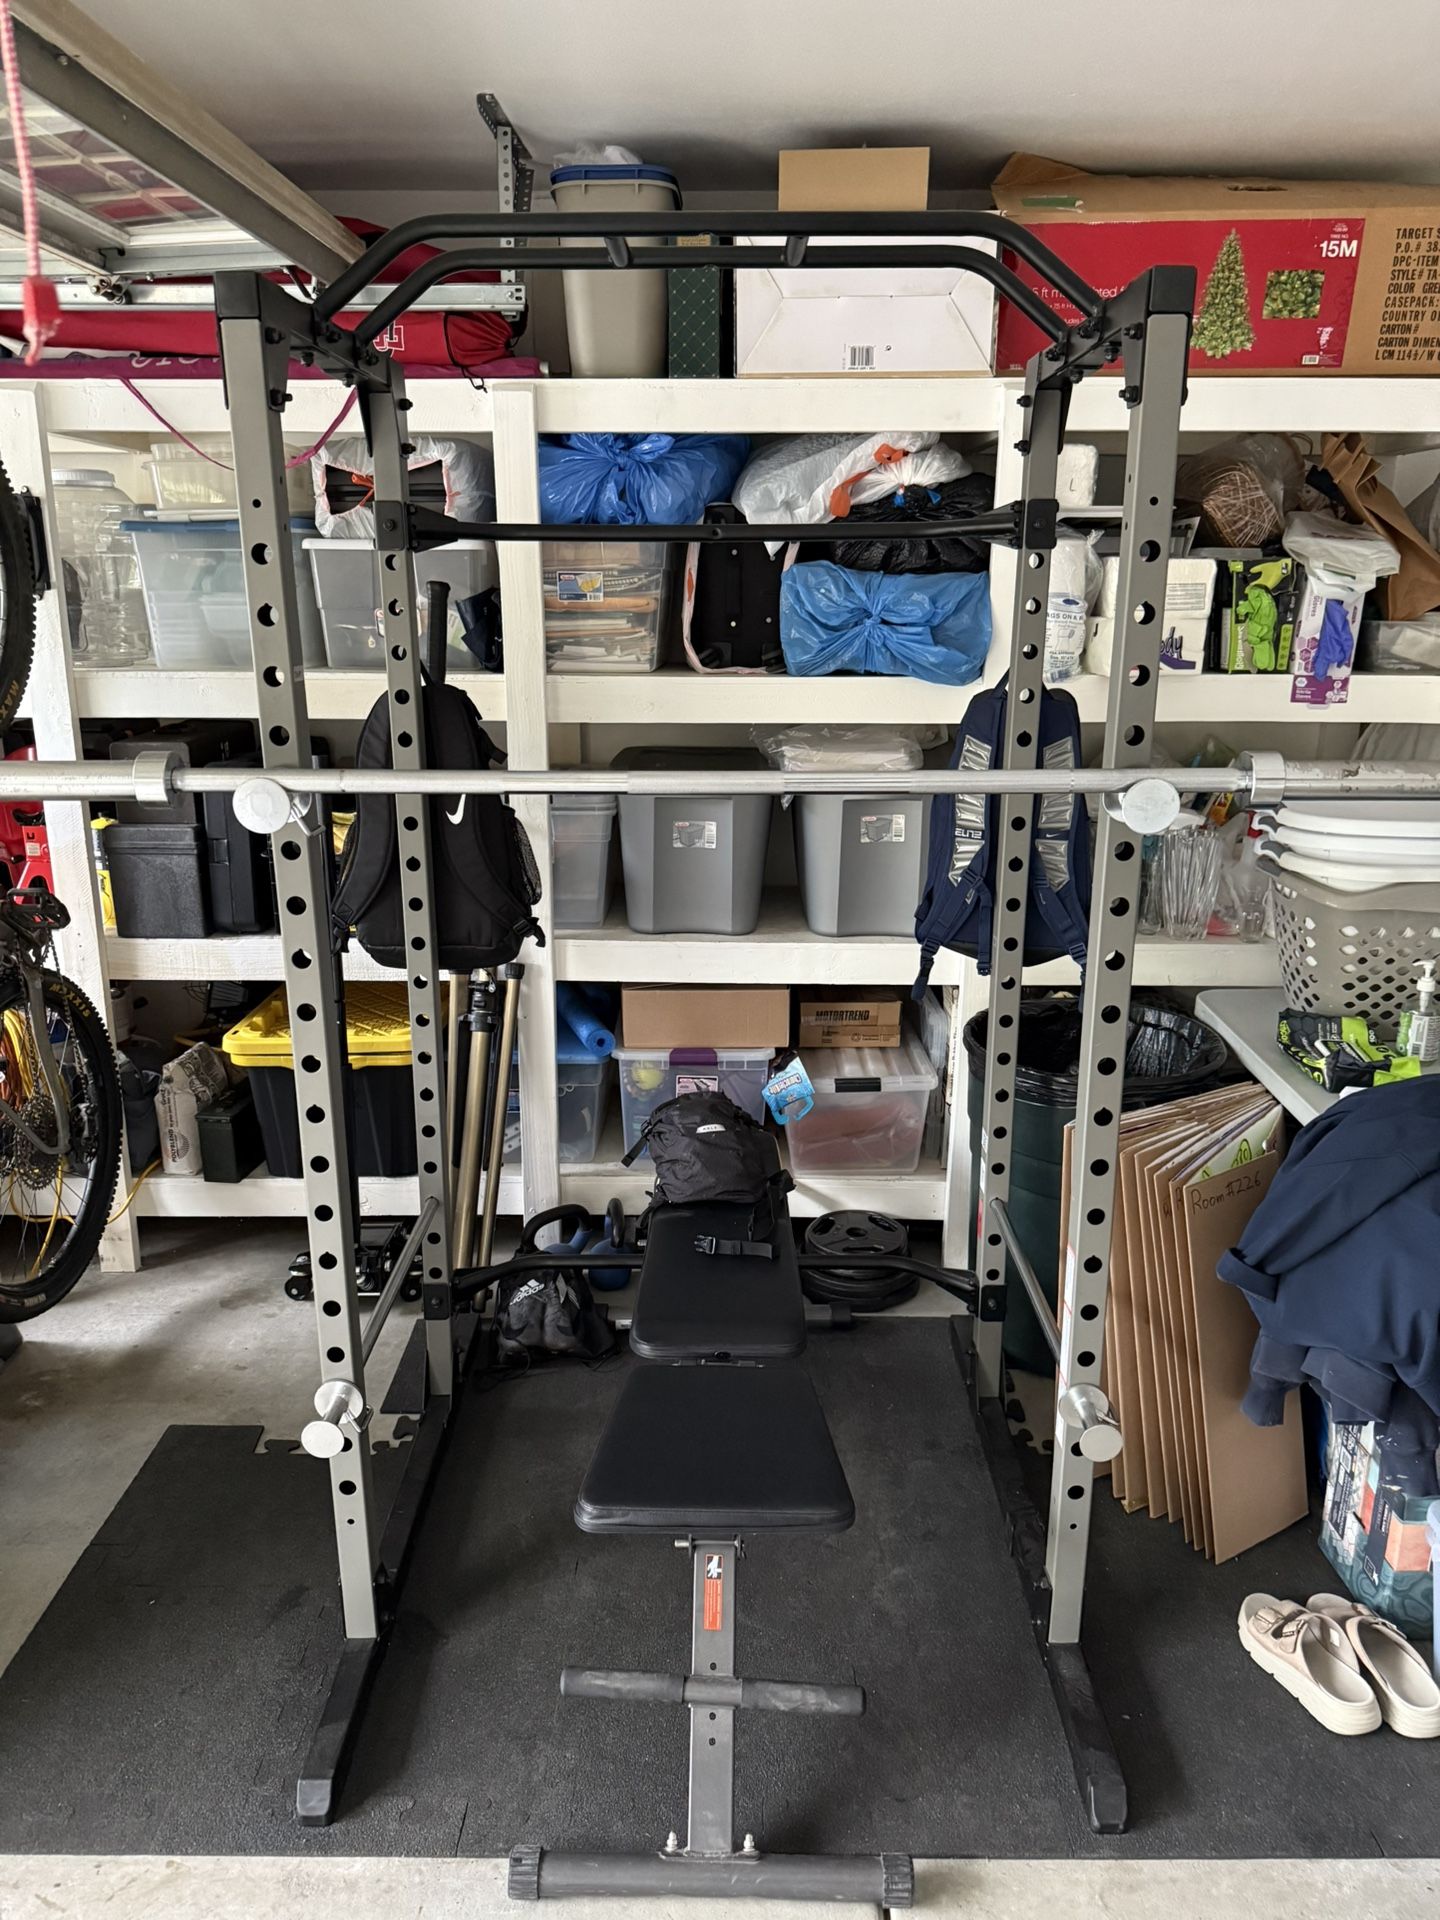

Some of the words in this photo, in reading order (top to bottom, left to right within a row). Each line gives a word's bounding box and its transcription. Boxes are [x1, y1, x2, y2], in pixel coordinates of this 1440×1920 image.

[1396, 227, 1433, 239] TARGET
[1319, 239, 1358, 258] 15M
[1426, 241, 1440, 253] 38
[1392, 255, 1439, 267] DPC-ITEM
[1427, 268, 1440, 281] TA-
[1387, 282, 1416, 294] COLOR
[1422, 282, 1440, 294] GRE
[1384, 296, 1440, 308] CASEPACK:
[1382, 310, 1427, 322] COUNTRY
[1377, 337, 1410, 348] CARTON
[1412, 337, 1440, 348] DIMEN
[814, 1009, 871, 1022] MOTORTREND
